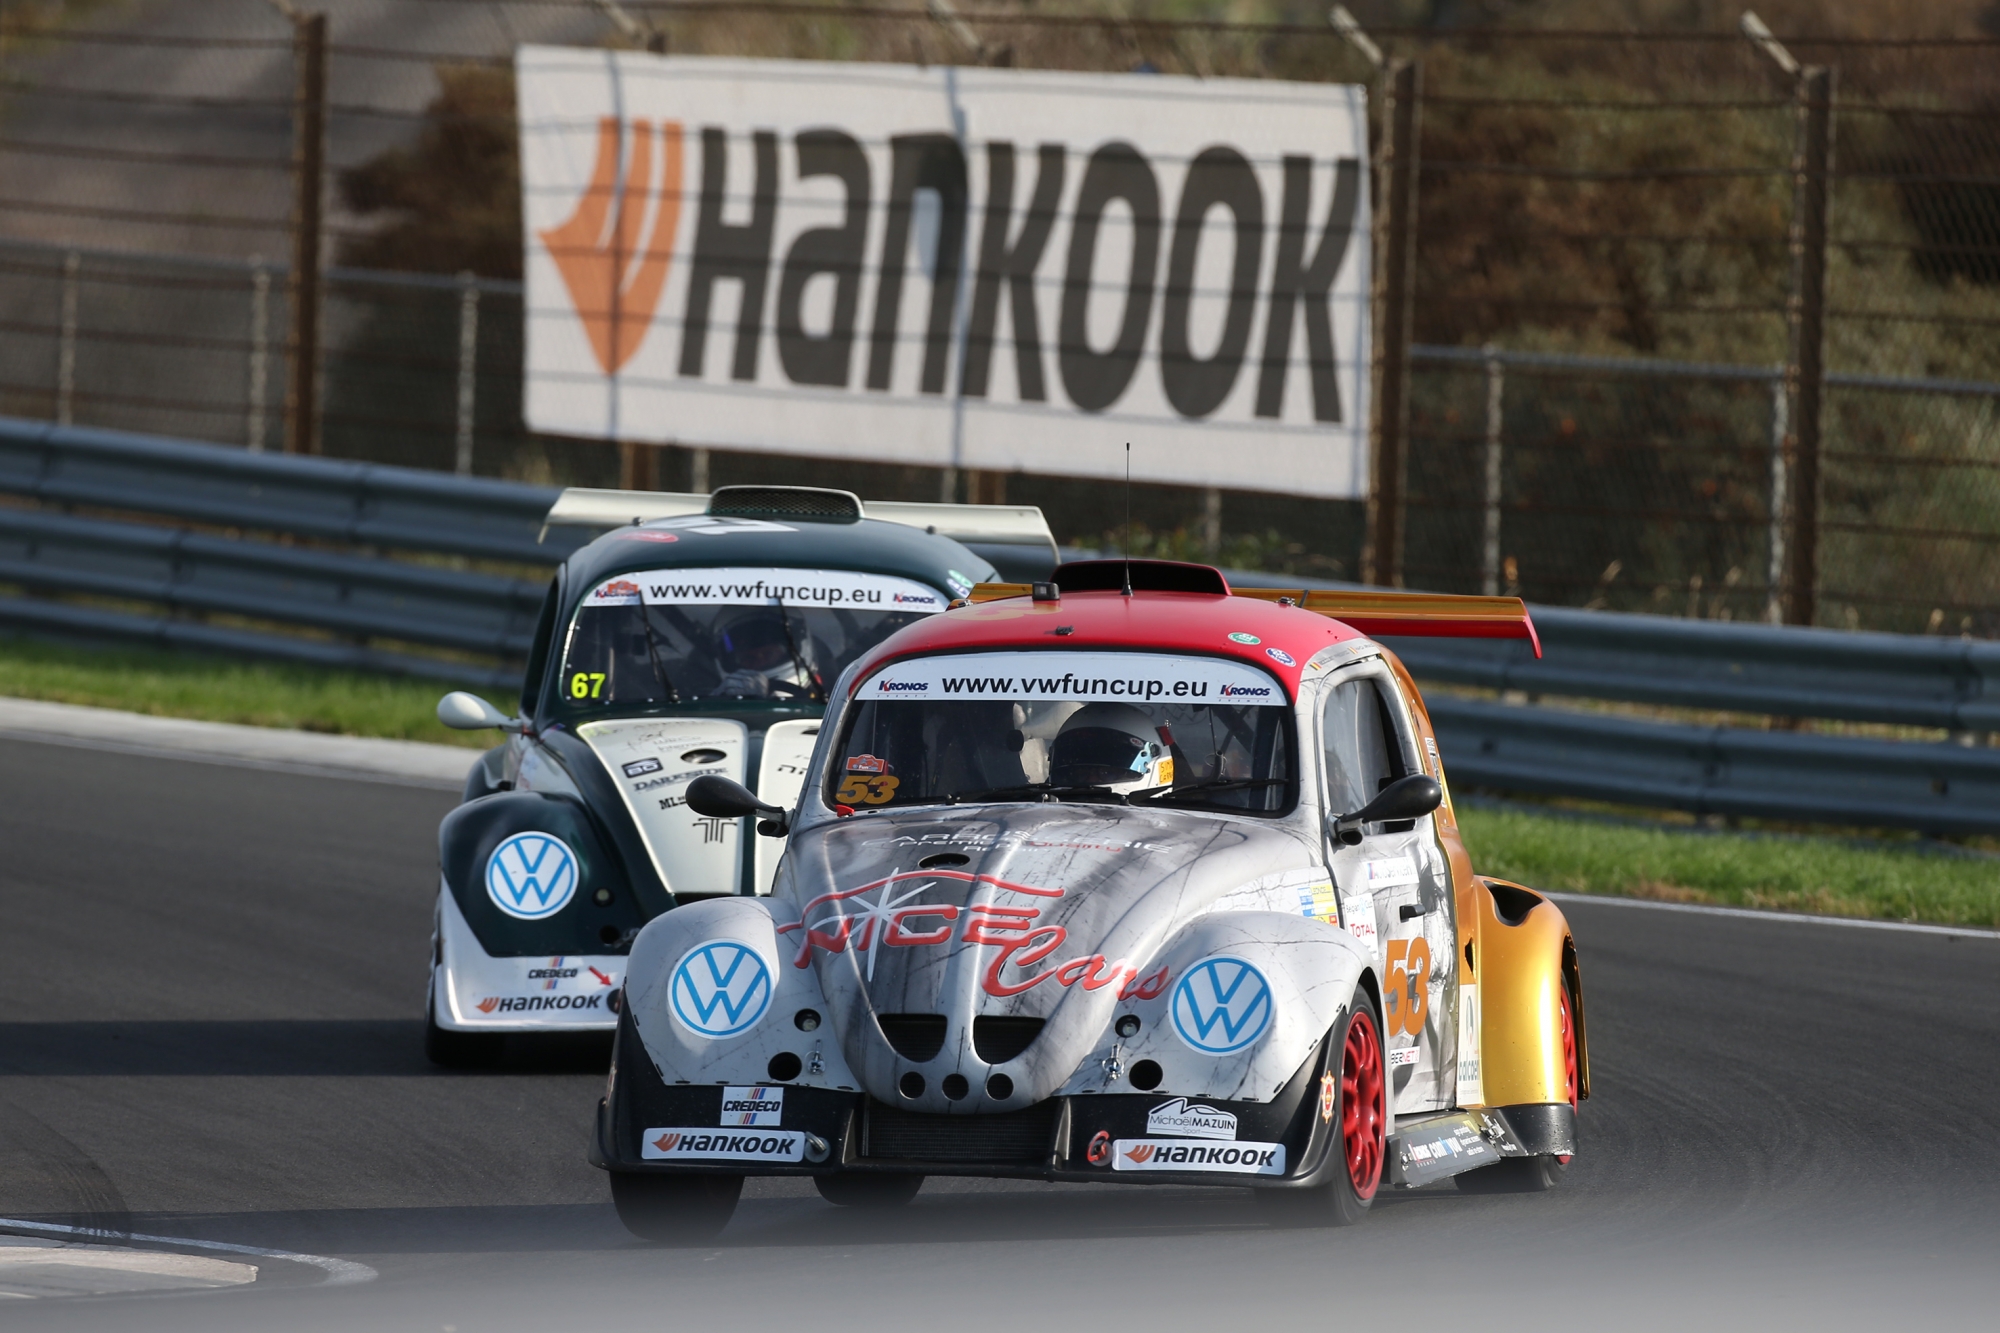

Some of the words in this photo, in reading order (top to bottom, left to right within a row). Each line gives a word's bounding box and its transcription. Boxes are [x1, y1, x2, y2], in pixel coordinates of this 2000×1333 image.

[650, 581, 882, 606] www.vwfuncup.eu
[893, 593, 936, 605] KRONOS
[571, 672, 606, 698] 67
[879, 678, 929, 691] KRONOS
[942, 672, 1208, 701] www.vwfuncup.eu
[1220, 682, 1271, 697] KRONOS
[835, 775, 900, 804] 53
[1350, 923, 1375, 938] TOTAL
[982, 925, 1174, 1000] Cars
[528, 968, 578, 979] CREDECO
[1383, 937, 1431, 1037] 53
[723, 1100, 781, 1112] CREDECO
[1182, 1127, 1201, 1135] Sport
